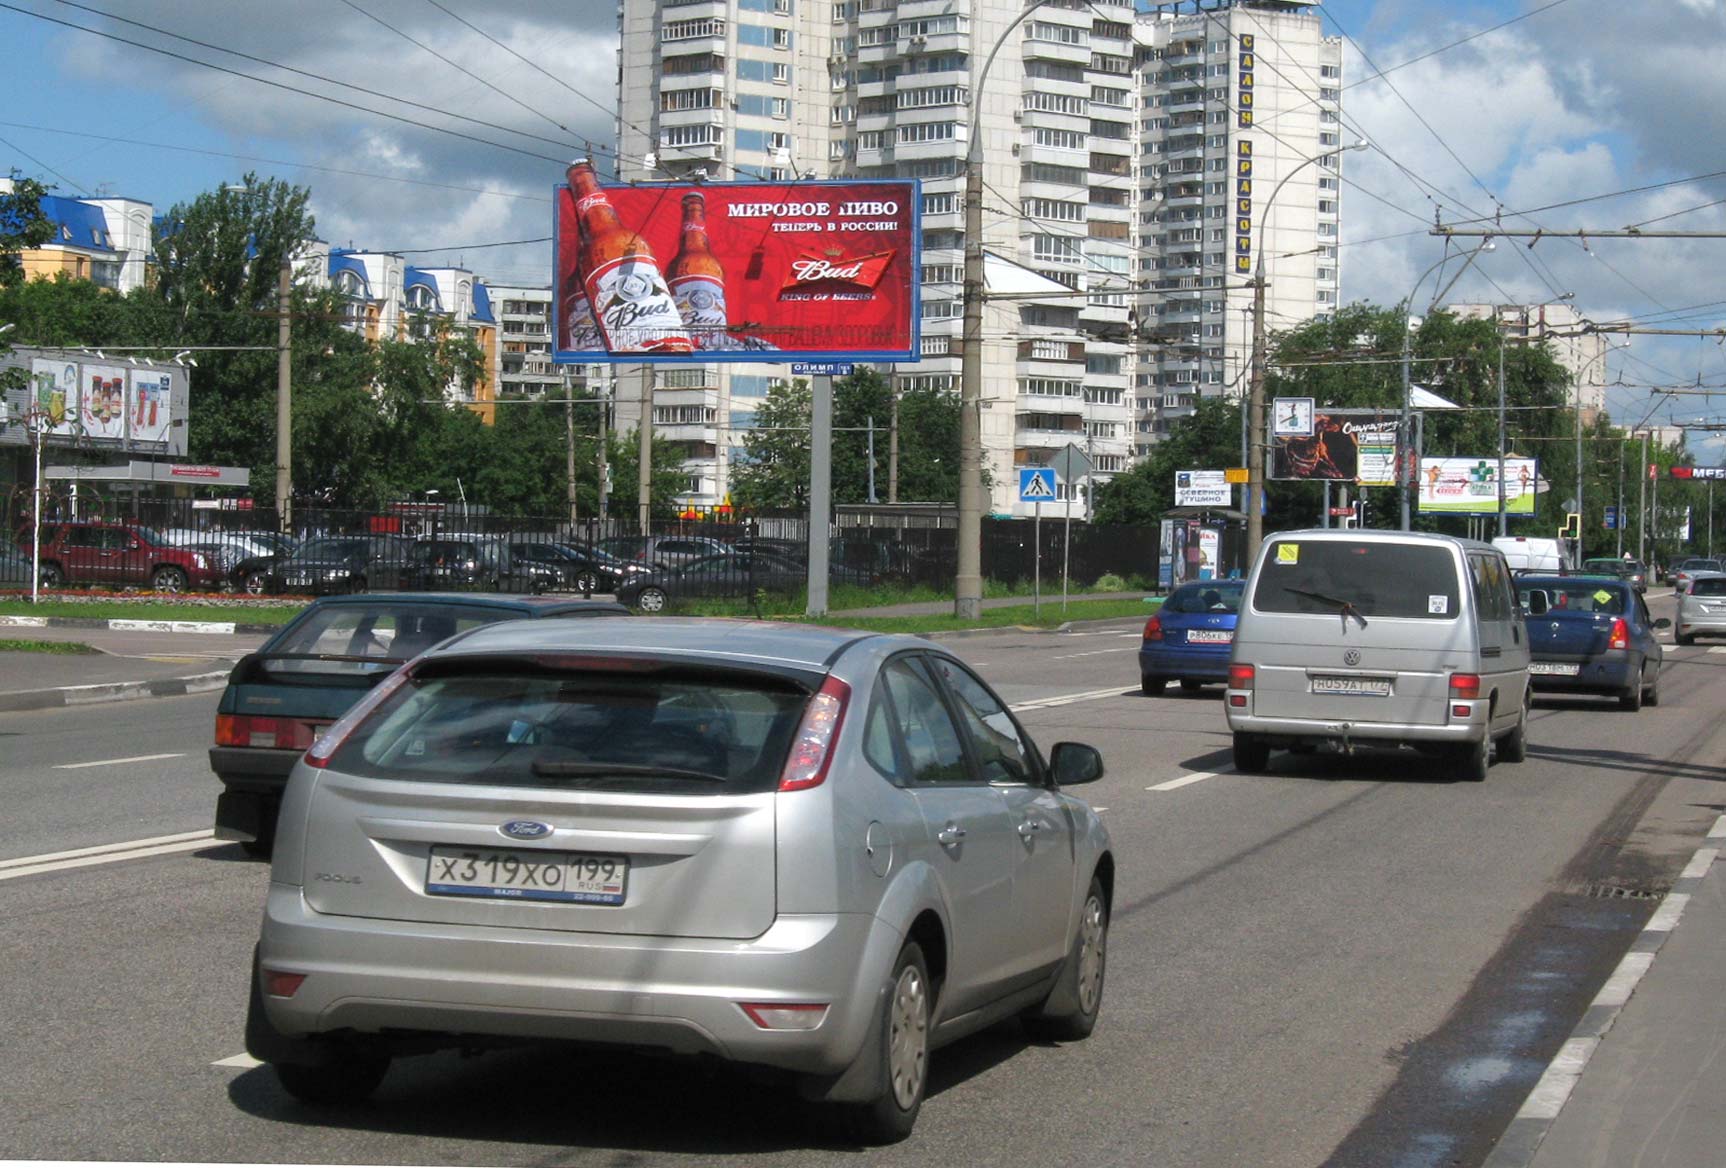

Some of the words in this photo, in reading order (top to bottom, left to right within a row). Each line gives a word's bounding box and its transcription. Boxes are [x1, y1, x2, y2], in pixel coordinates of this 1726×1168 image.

[1240, 35, 1252, 125] САЛОН
[727, 202, 830, 217] МИРОВОЕ
[838, 201, 898, 216] ПИВО
[1238, 141, 1252, 271] КРАСОТЫ
[772, 223, 822, 232] ТЕПЕРЬ
[827, 222, 836, 231] В
[841, 222, 898, 231] РОССИИ!
[792, 260, 864, 281] Bud
[606, 301, 670, 331] Bud
[1692, 468, 1726, 479] МЕБ
[510, 821, 543, 835] Ford
[570, 857, 616, 881] 199
[578, 881, 602, 891] RUS
